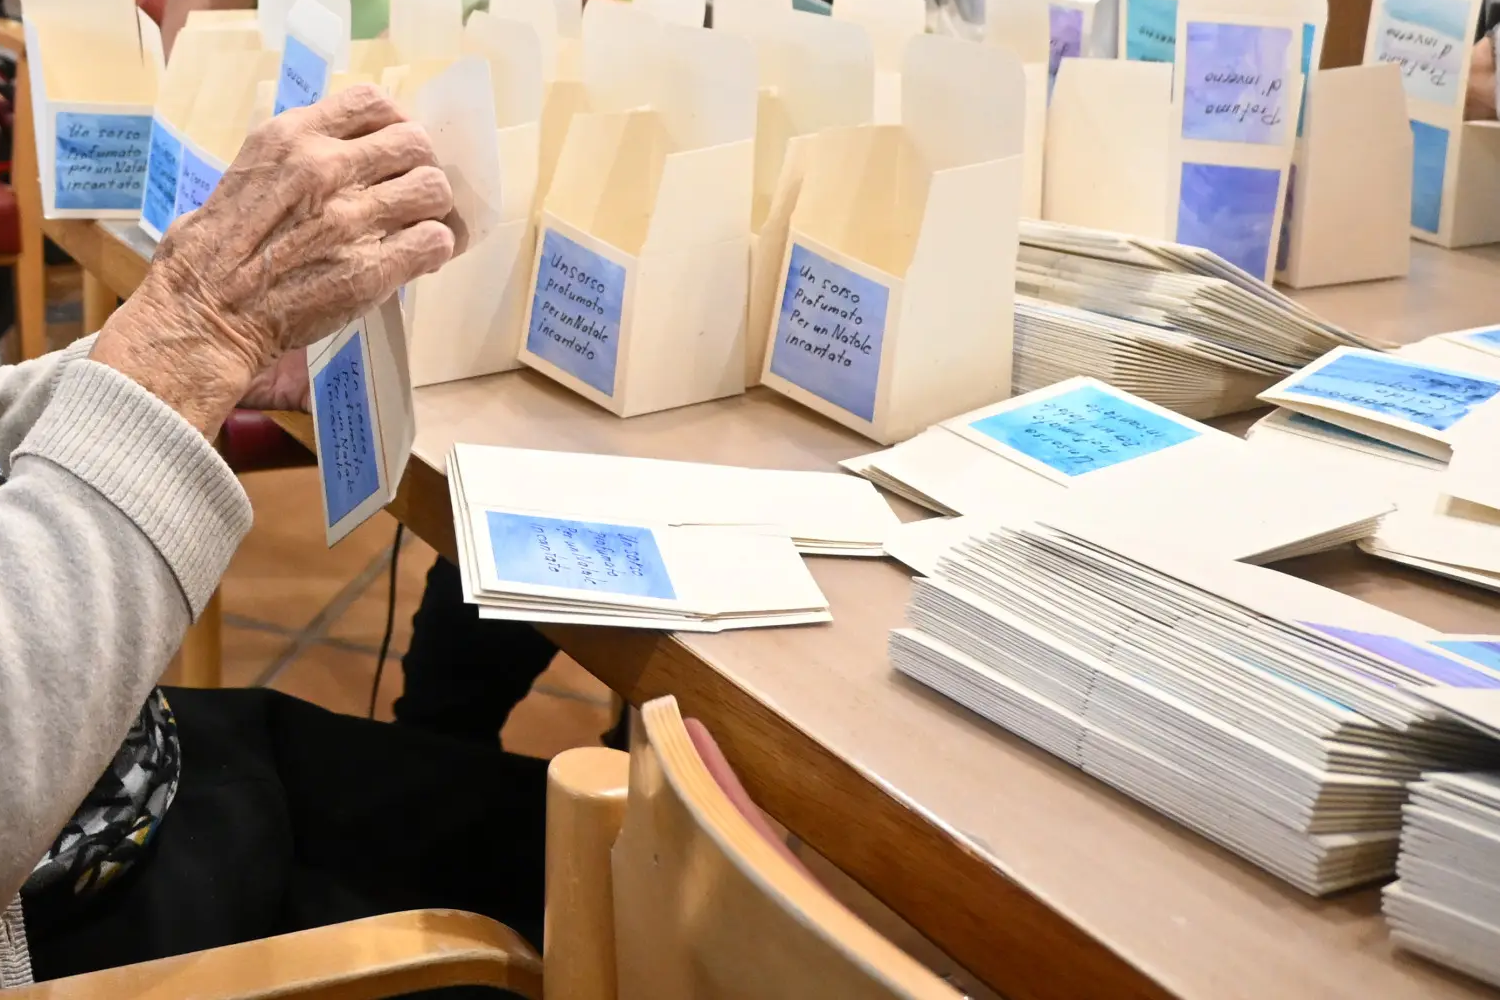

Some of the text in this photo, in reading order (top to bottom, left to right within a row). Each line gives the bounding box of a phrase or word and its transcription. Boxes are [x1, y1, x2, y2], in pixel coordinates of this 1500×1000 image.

[66, 121, 141, 141] Un sorso
[1204, 101, 1282, 126] Profumo
[799, 264, 861, 304] Un sorso
[537, 317, 596, 361] incantato
[785, 332, 853, 368] incantato
[813, 322, 829, 336] un
[830, 323, 873, 356] Natale
